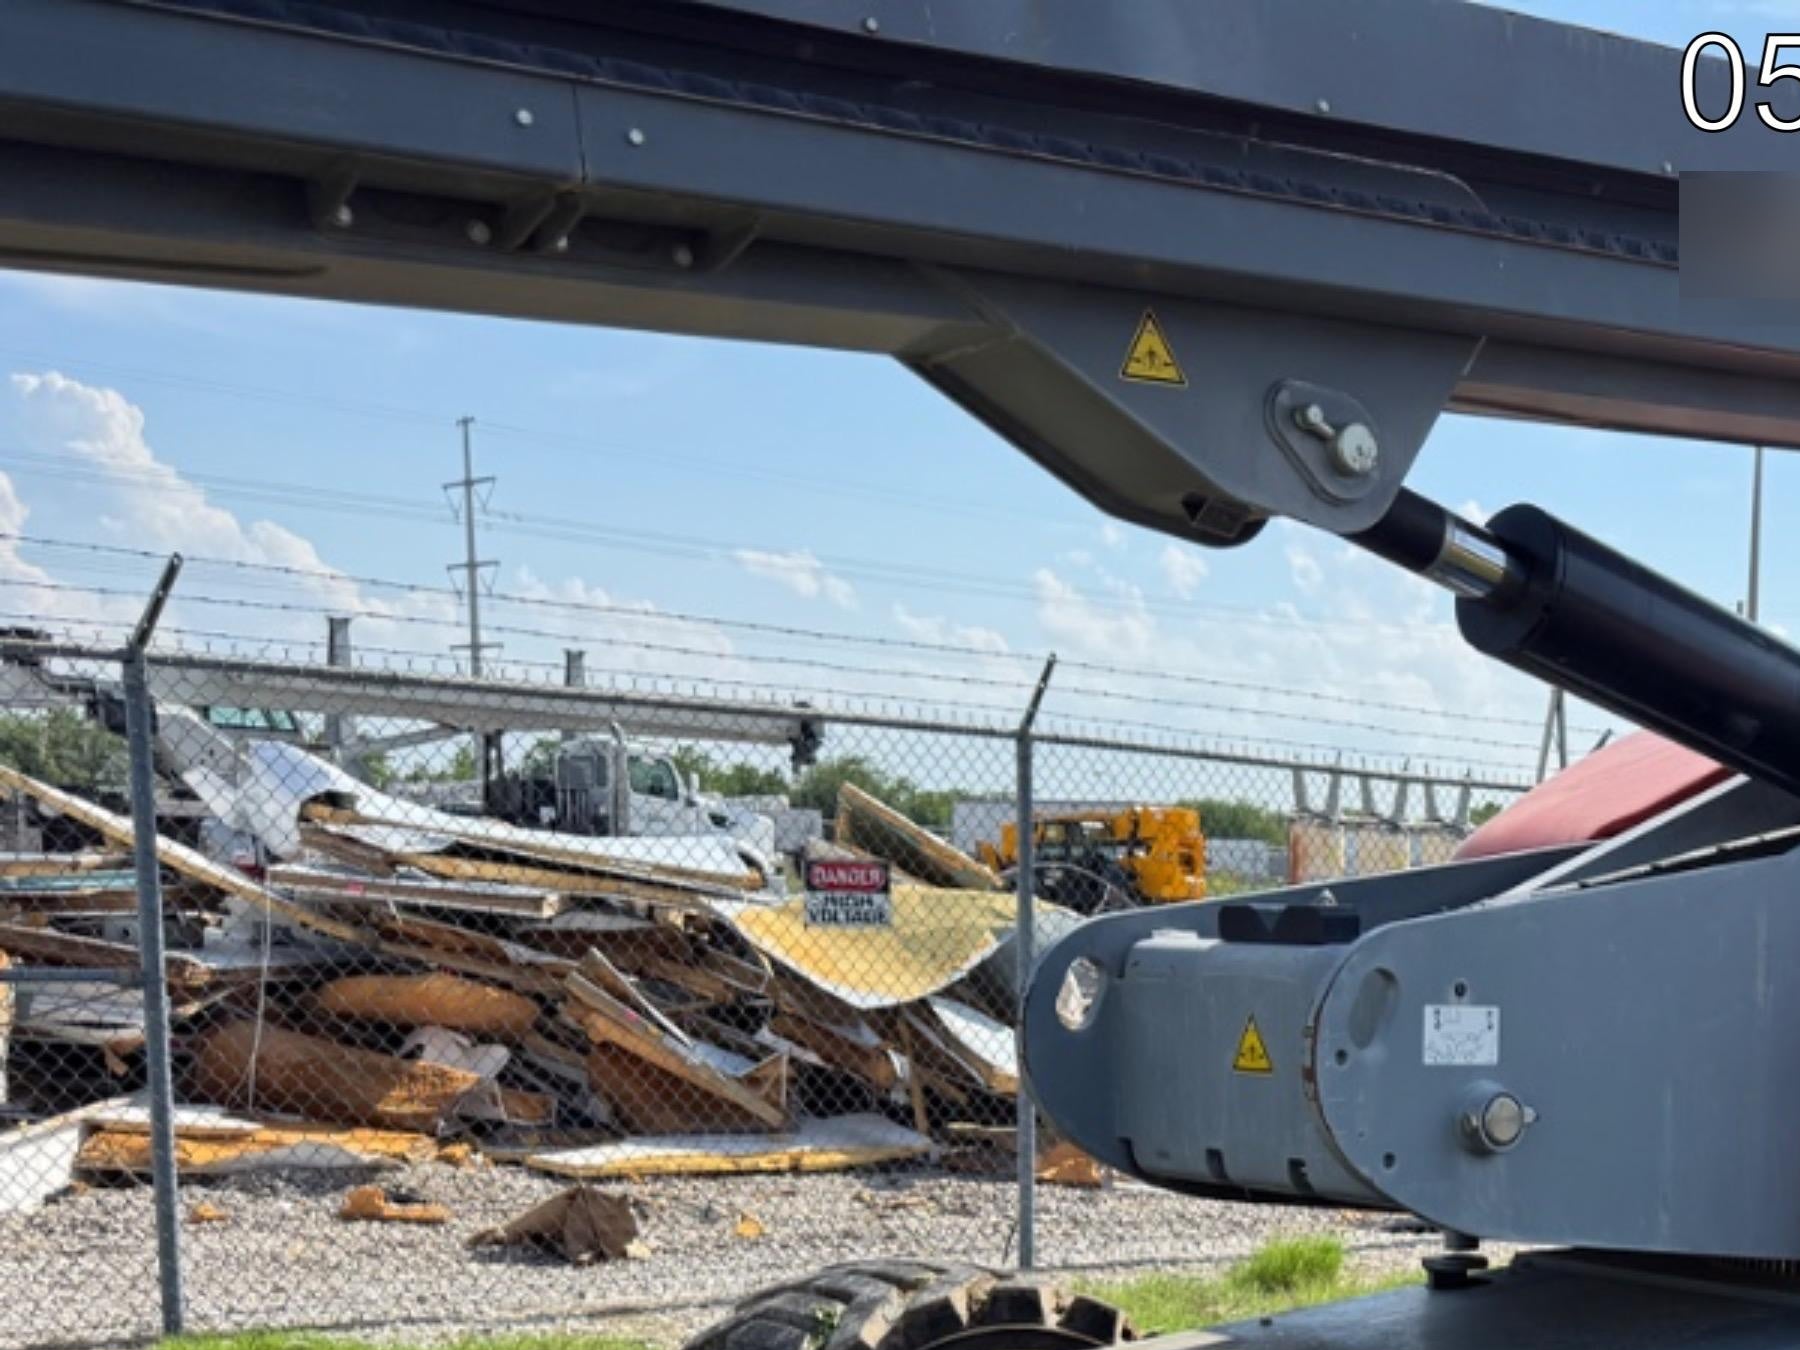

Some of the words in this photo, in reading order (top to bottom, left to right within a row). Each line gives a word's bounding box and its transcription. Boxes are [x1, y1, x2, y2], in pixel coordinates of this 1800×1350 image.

[811, 865, 881, 887] DANGER
[823, 894, 874, 907] HIGH
[808, 908, 886, 922] VOLTAGE
